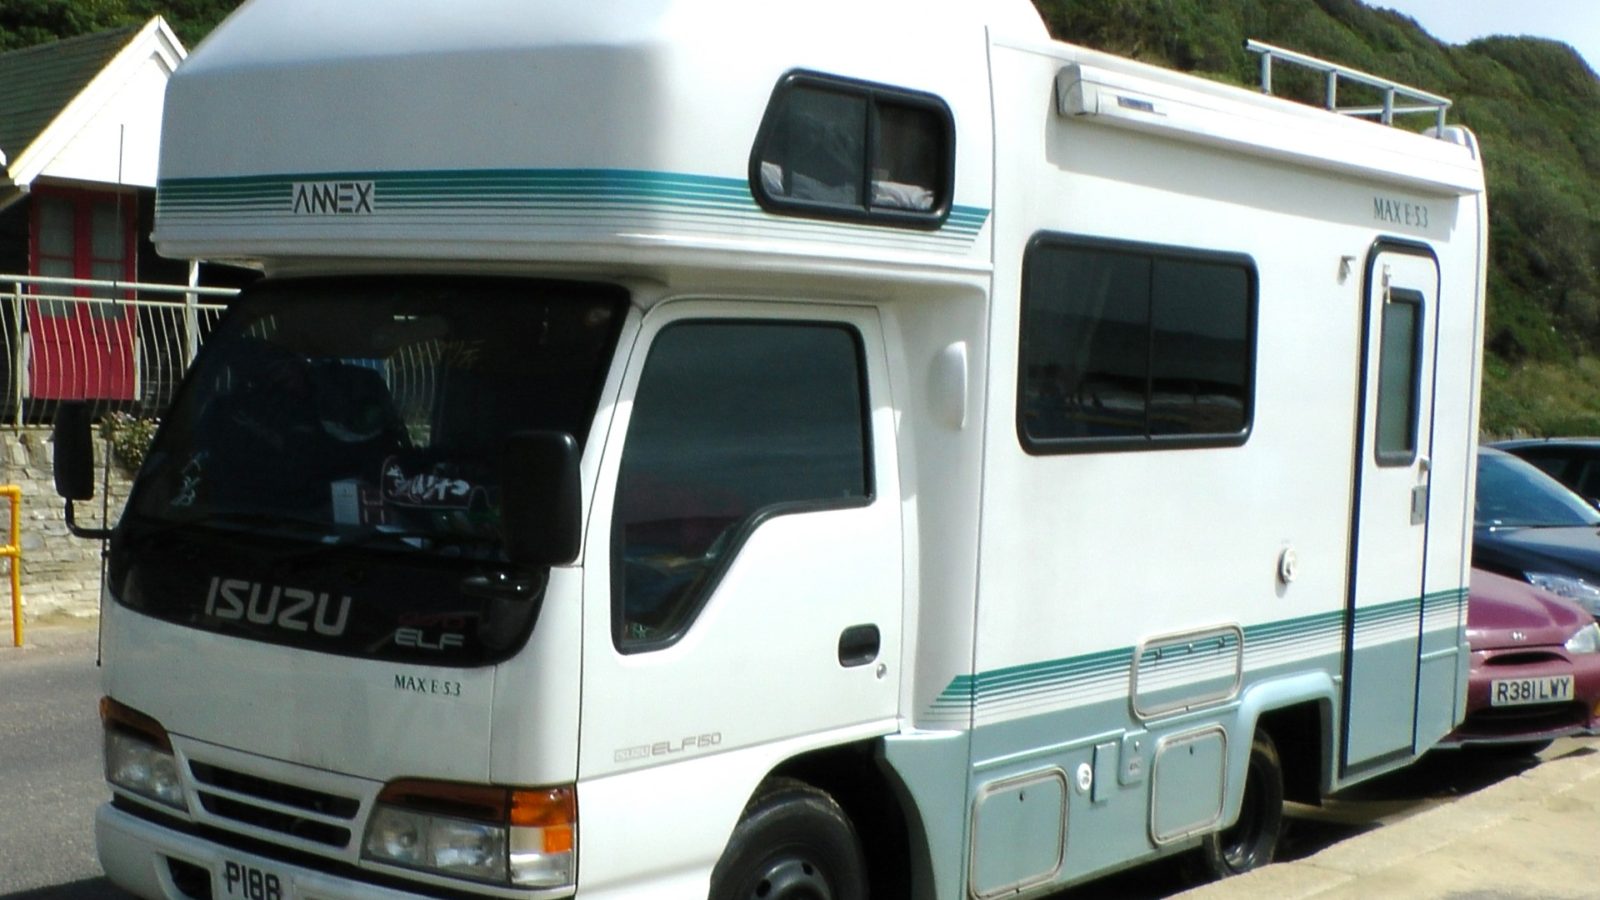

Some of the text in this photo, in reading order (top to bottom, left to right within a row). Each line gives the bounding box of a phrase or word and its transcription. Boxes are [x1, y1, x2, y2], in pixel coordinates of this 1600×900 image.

[294, 183, 372, 214] ANNEX
[1373, 196, 1401, 224] MAX
[204, 576, 352, 636] ISUZU
[394, 627, 465, 651] ELF
[394, 674, 426, 693] MAX
